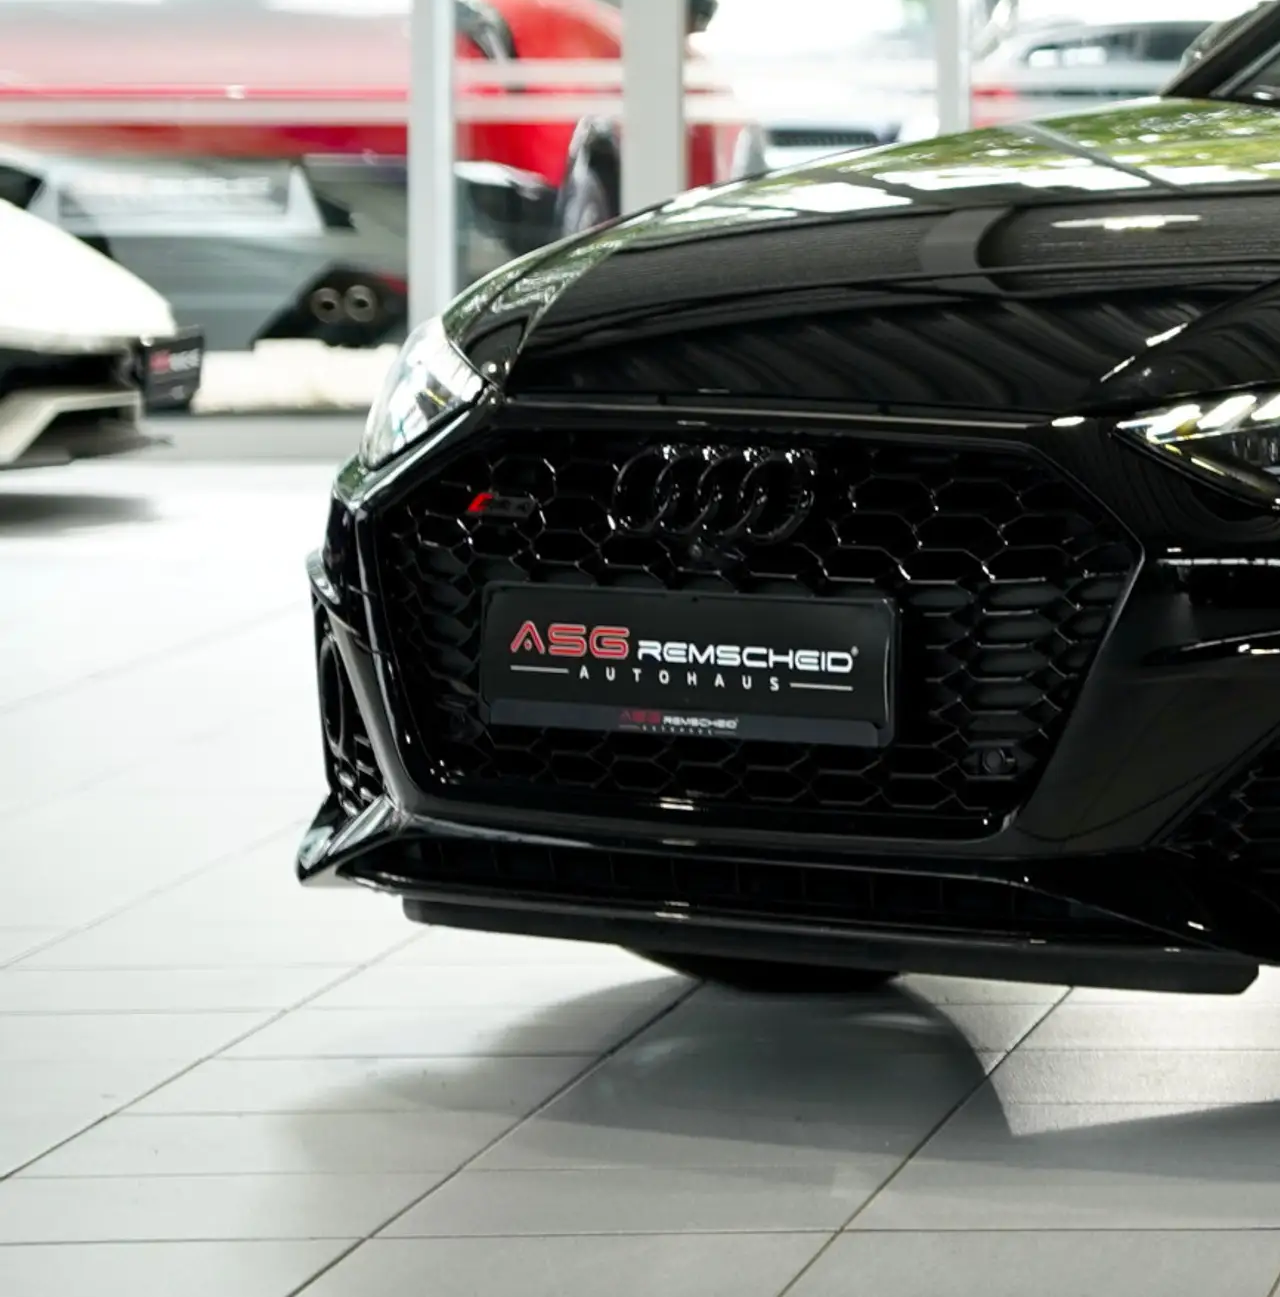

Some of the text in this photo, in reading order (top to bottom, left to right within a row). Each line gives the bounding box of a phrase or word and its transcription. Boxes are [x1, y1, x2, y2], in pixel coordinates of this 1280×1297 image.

[510, 620, 853, 673] ASG REMSCHEID
[579, 664, 780, 692] AUTOHAUS
